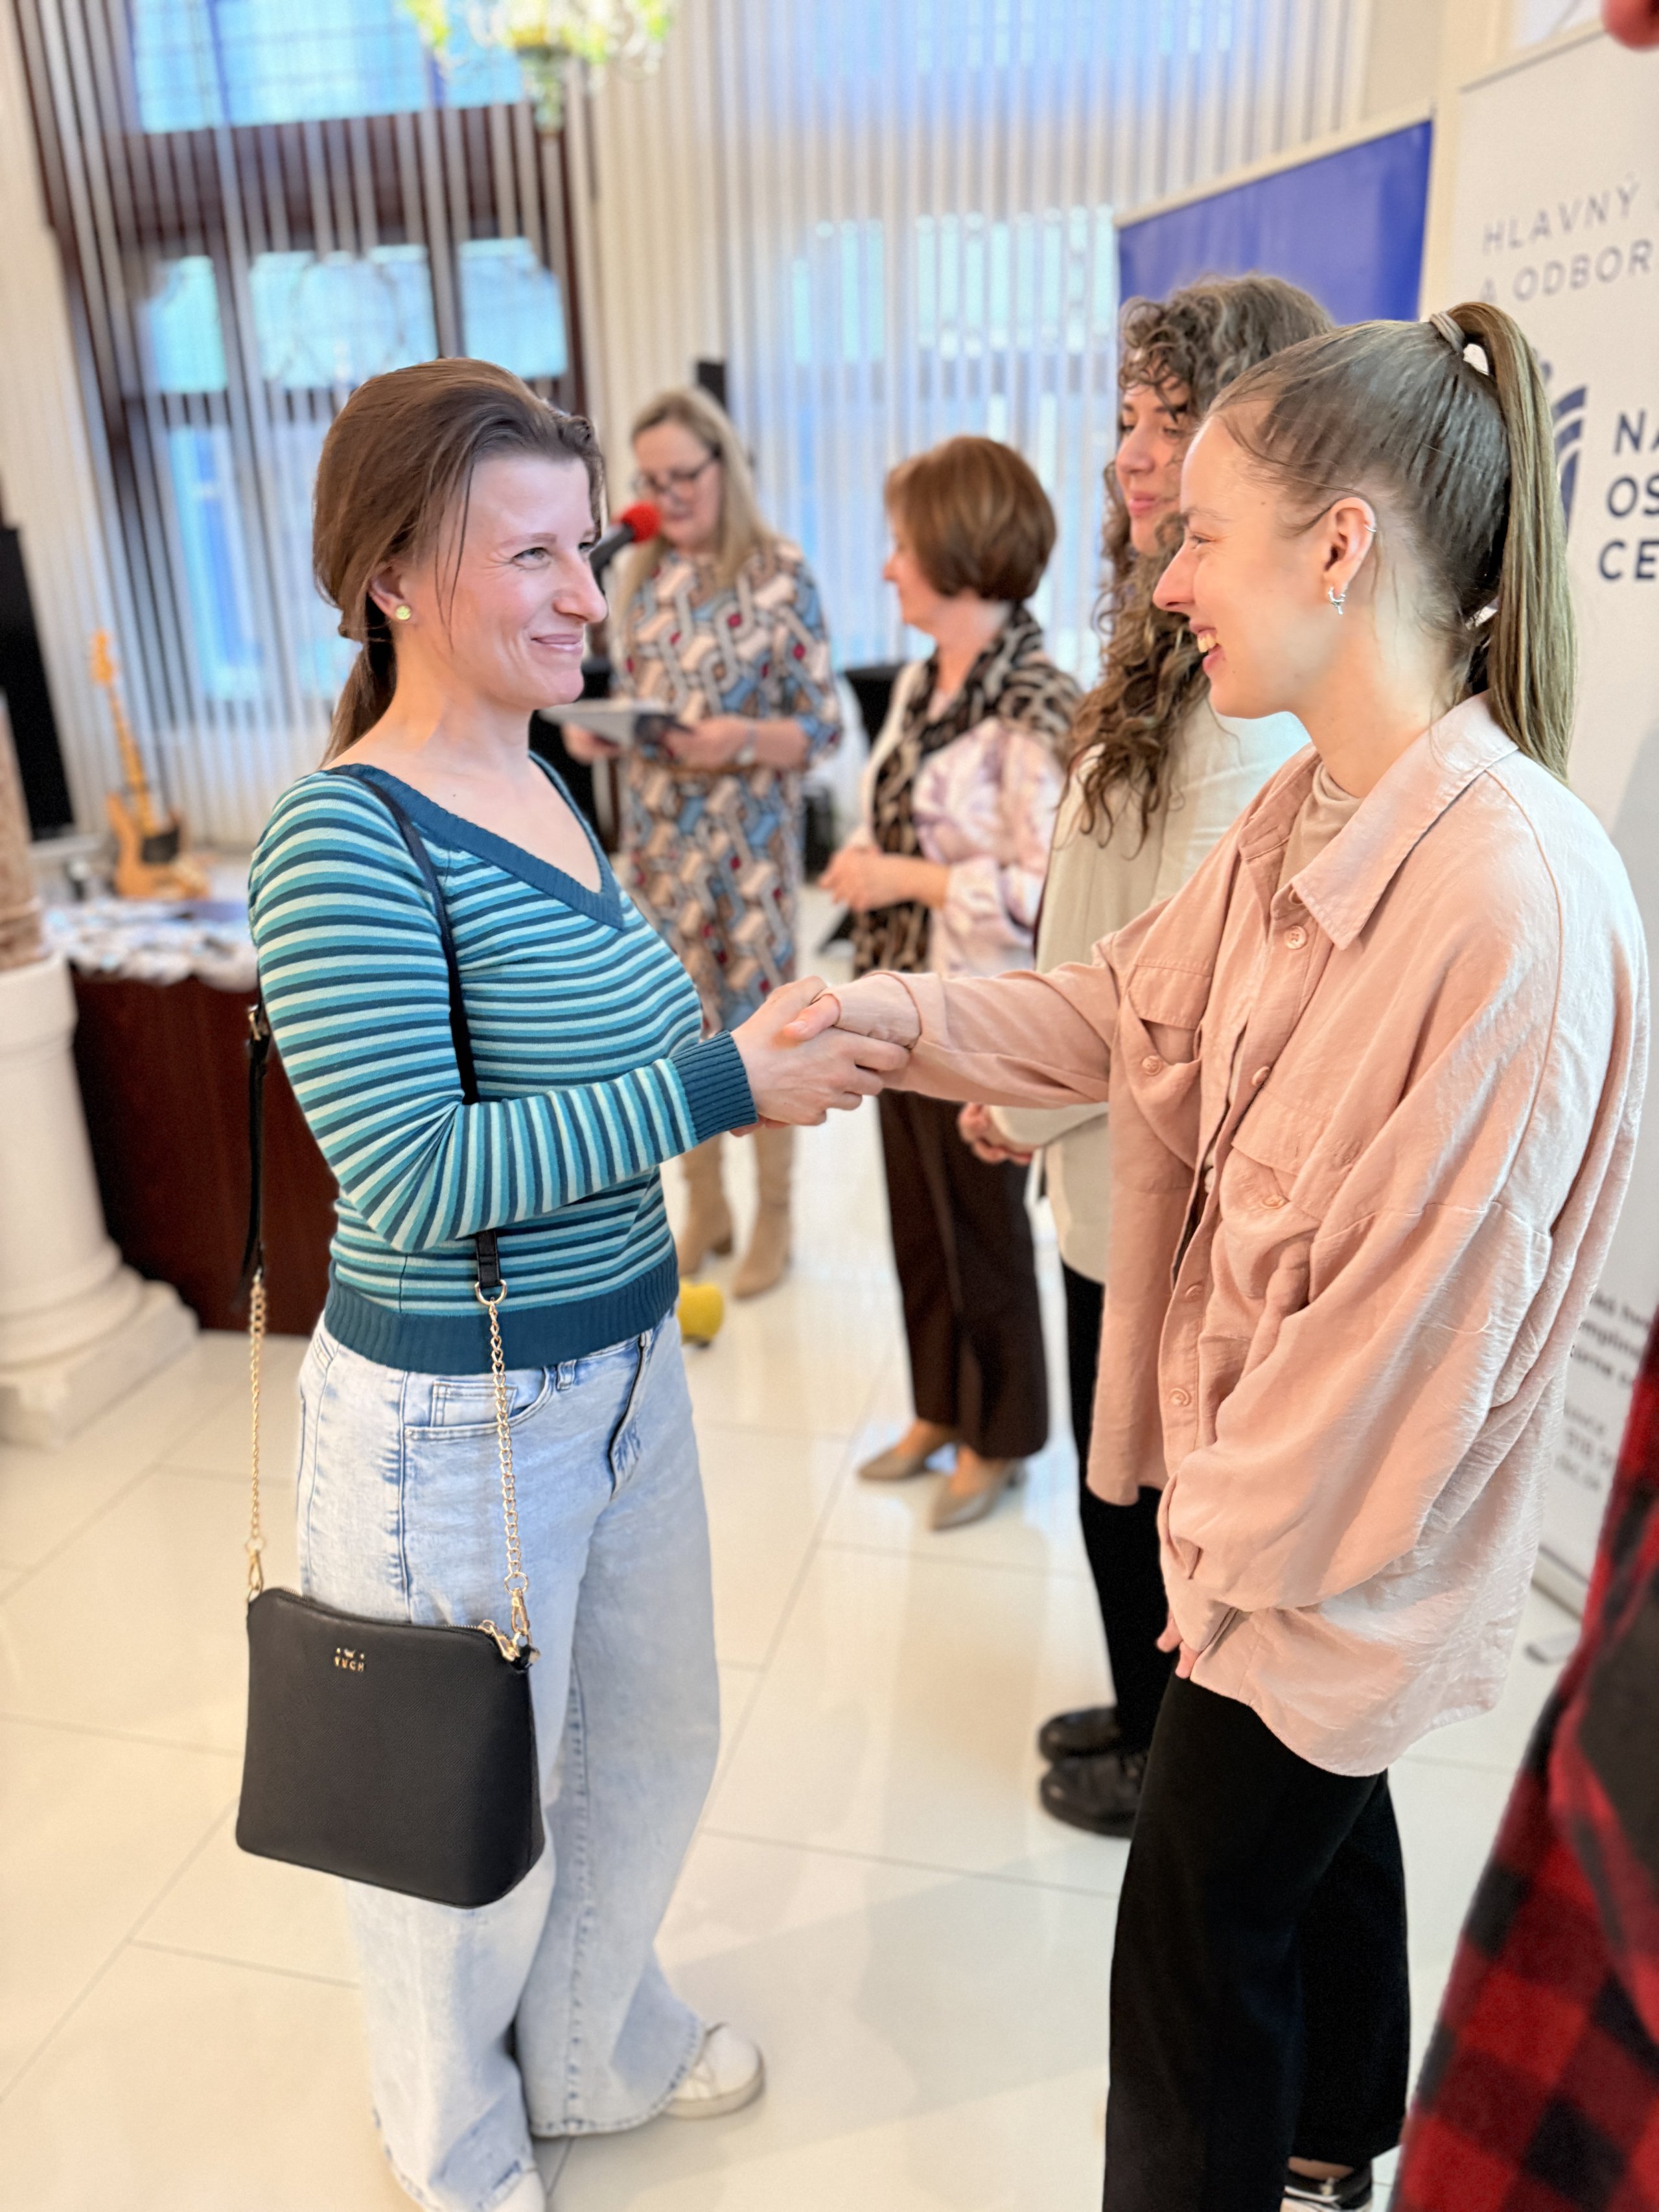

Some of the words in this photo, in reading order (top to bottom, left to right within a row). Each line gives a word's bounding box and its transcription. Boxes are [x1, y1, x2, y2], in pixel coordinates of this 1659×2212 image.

[1482, 172, 1640, 255] HLAVNÝ
[1513, 239, 1653, 302] ODBOR
[1614, 406, 1659, 455] N
[1599, 537, 1659, 580] CE
